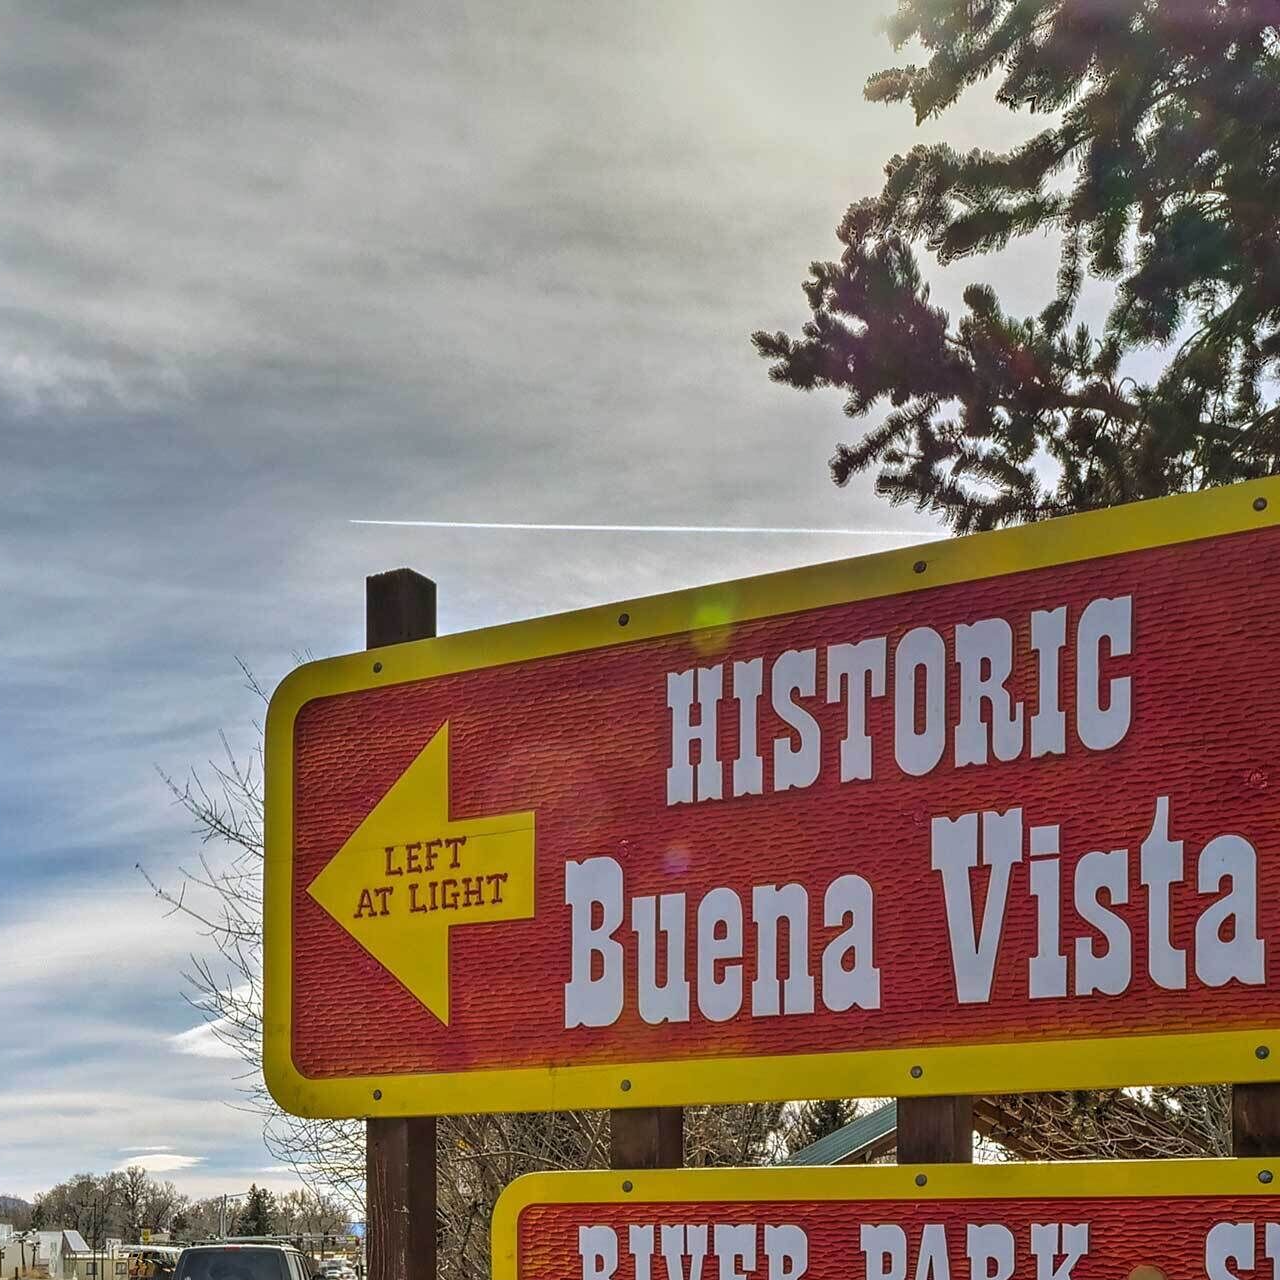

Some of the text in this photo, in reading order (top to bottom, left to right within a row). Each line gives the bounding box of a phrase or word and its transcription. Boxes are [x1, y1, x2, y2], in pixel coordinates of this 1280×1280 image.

[666, 595, 1133, 806] HISTORIC
[353, 873, 508, 919] AT LIGHT
[384, 836, 467, 877] LEFT
[564, 796, 1267, 1029] Buena Vista
